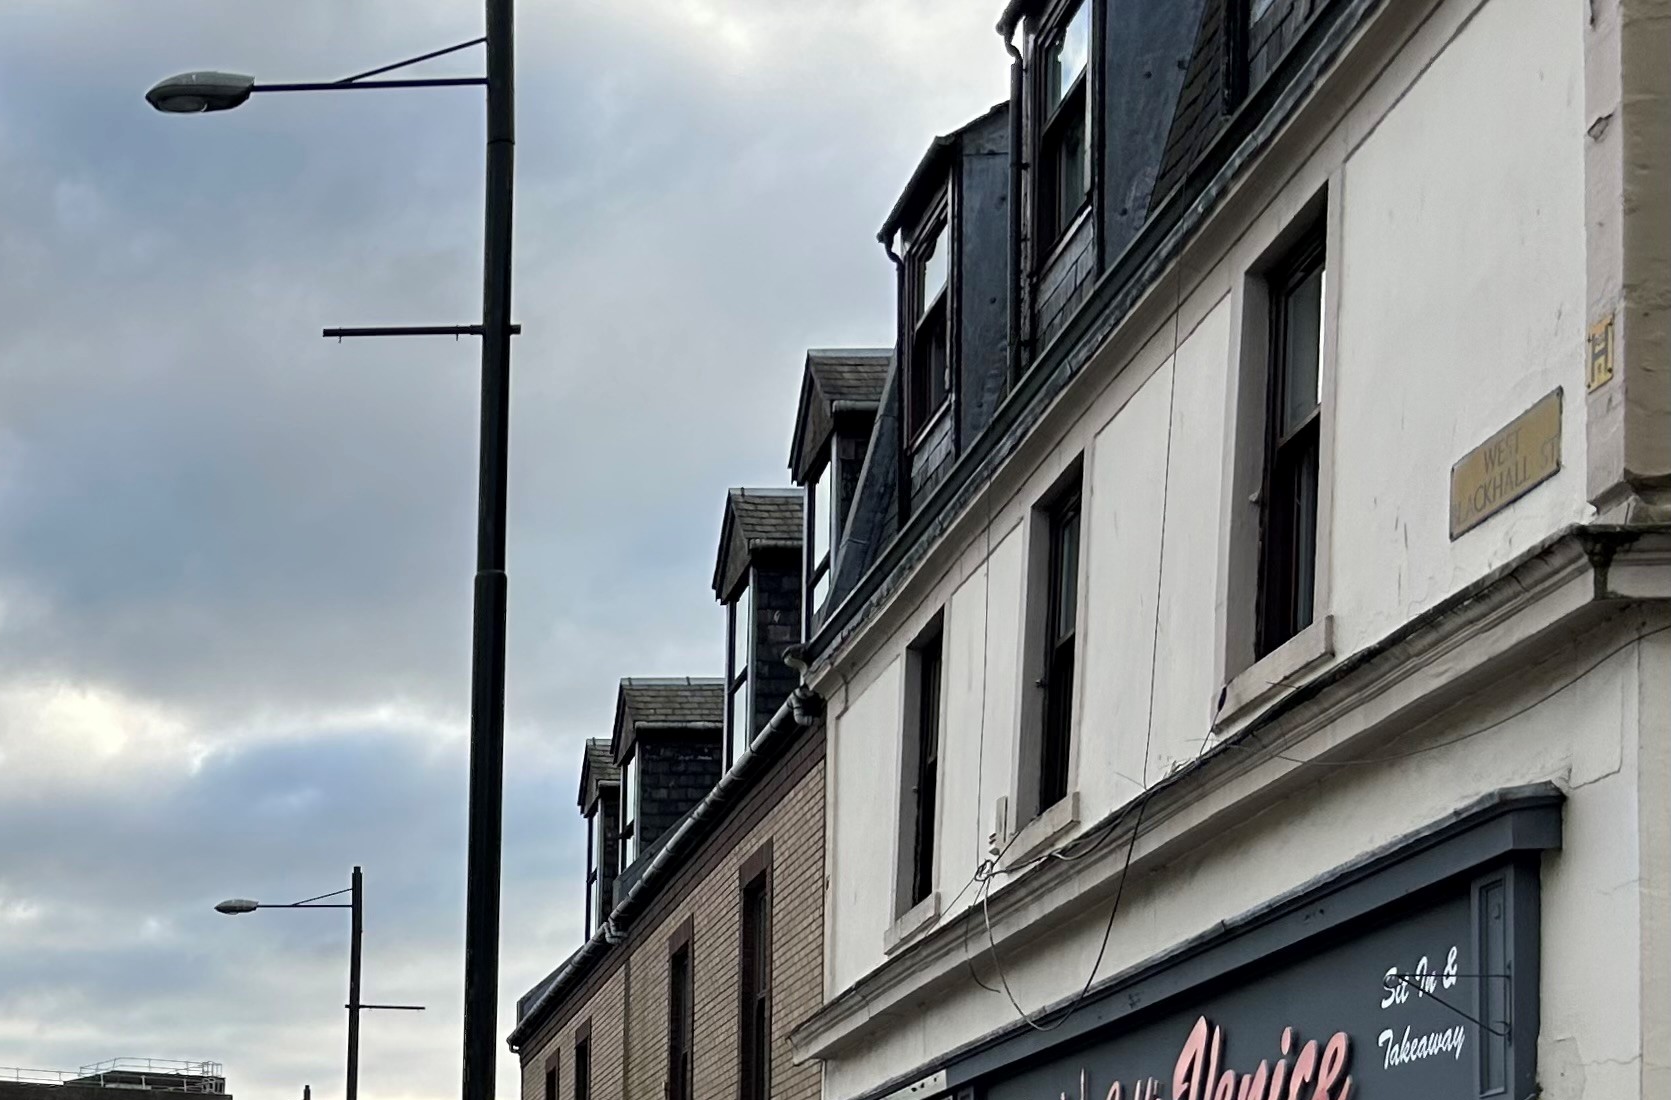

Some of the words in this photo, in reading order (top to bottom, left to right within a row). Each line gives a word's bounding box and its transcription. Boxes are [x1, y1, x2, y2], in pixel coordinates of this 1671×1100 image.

[1484, 427, 1521, 472] WEST
[1455, 456, 1530, 527] LACKHALL
[1381, 967, 1409, 1009] Sit
[1415, 956, 1437, 998] In
[1443, 946, 1457, 989] &
[1378, 1025, 1465, 1070] Takeaway
